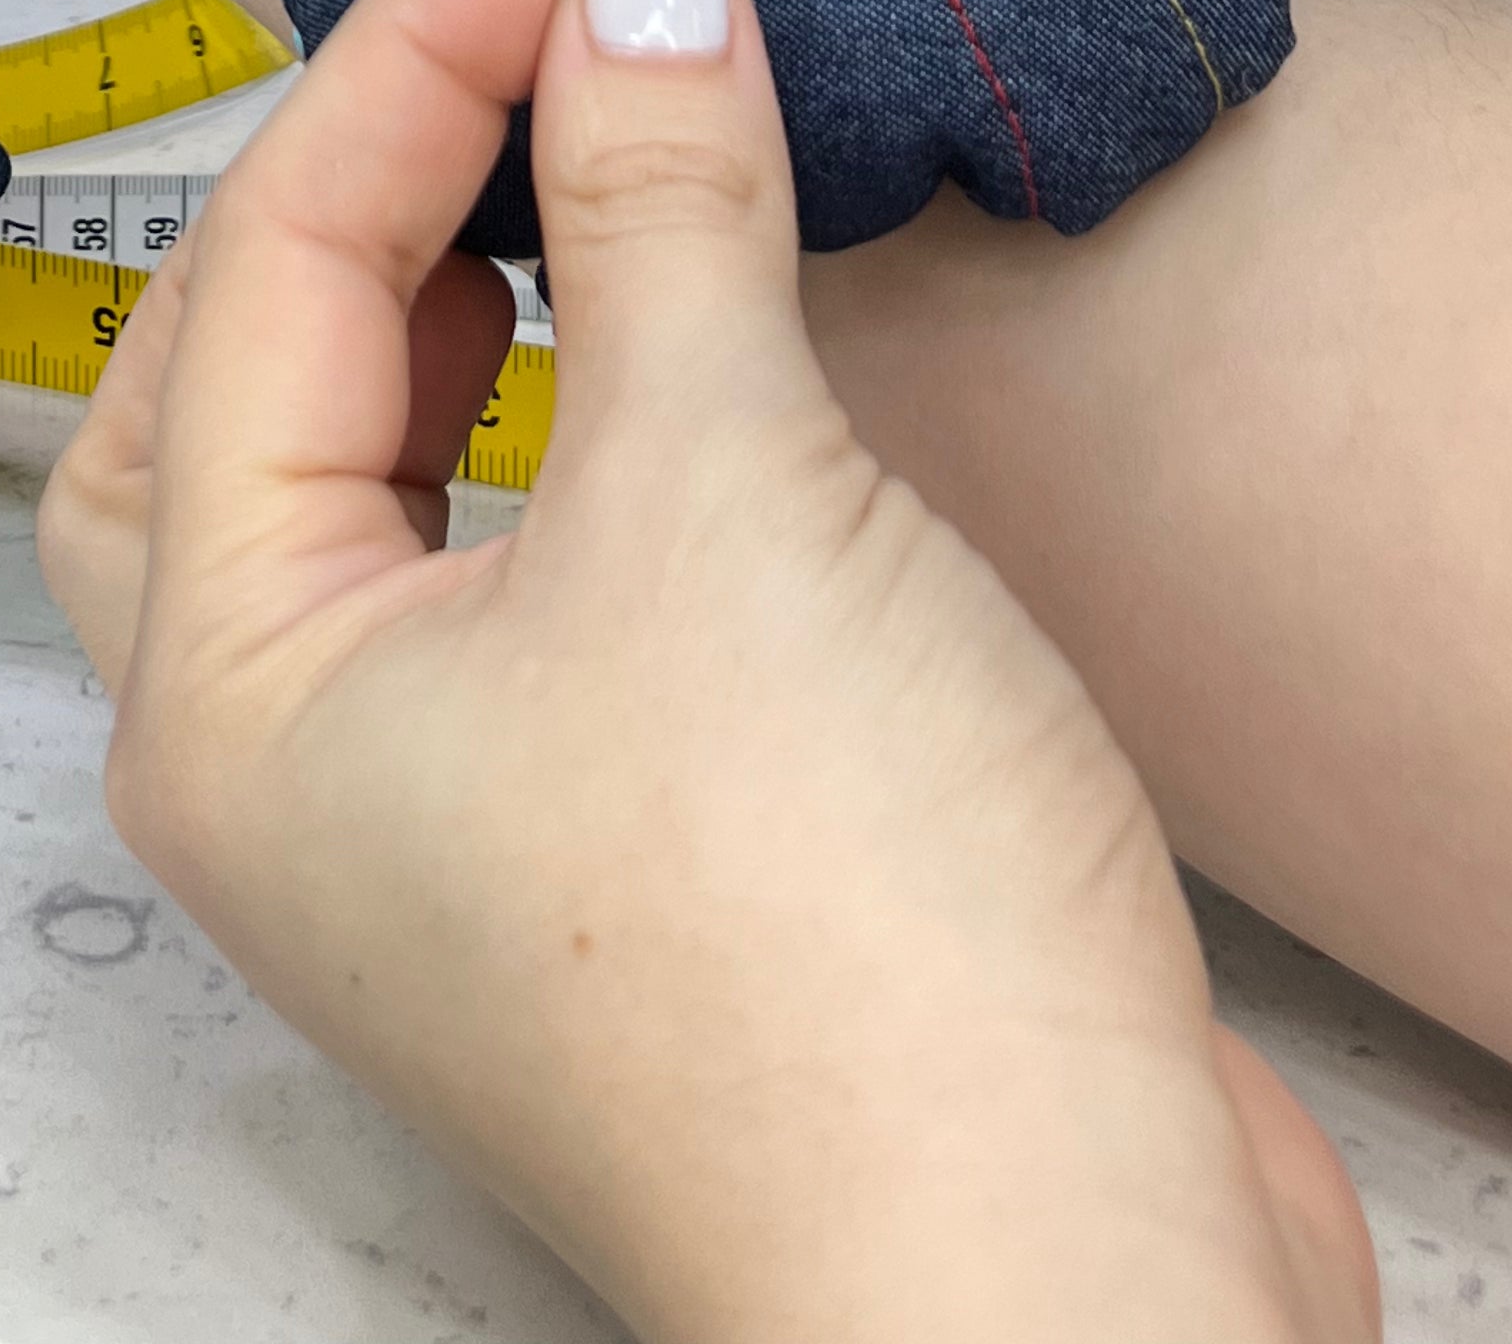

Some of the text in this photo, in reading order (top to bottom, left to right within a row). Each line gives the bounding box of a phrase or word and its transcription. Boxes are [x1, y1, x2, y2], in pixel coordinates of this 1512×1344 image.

[99, 56, 117, 91] 7
[72, 217, 108, 251] 58
[143, 216, 179, 251] 59
[92, 306, 130, 347] 5
